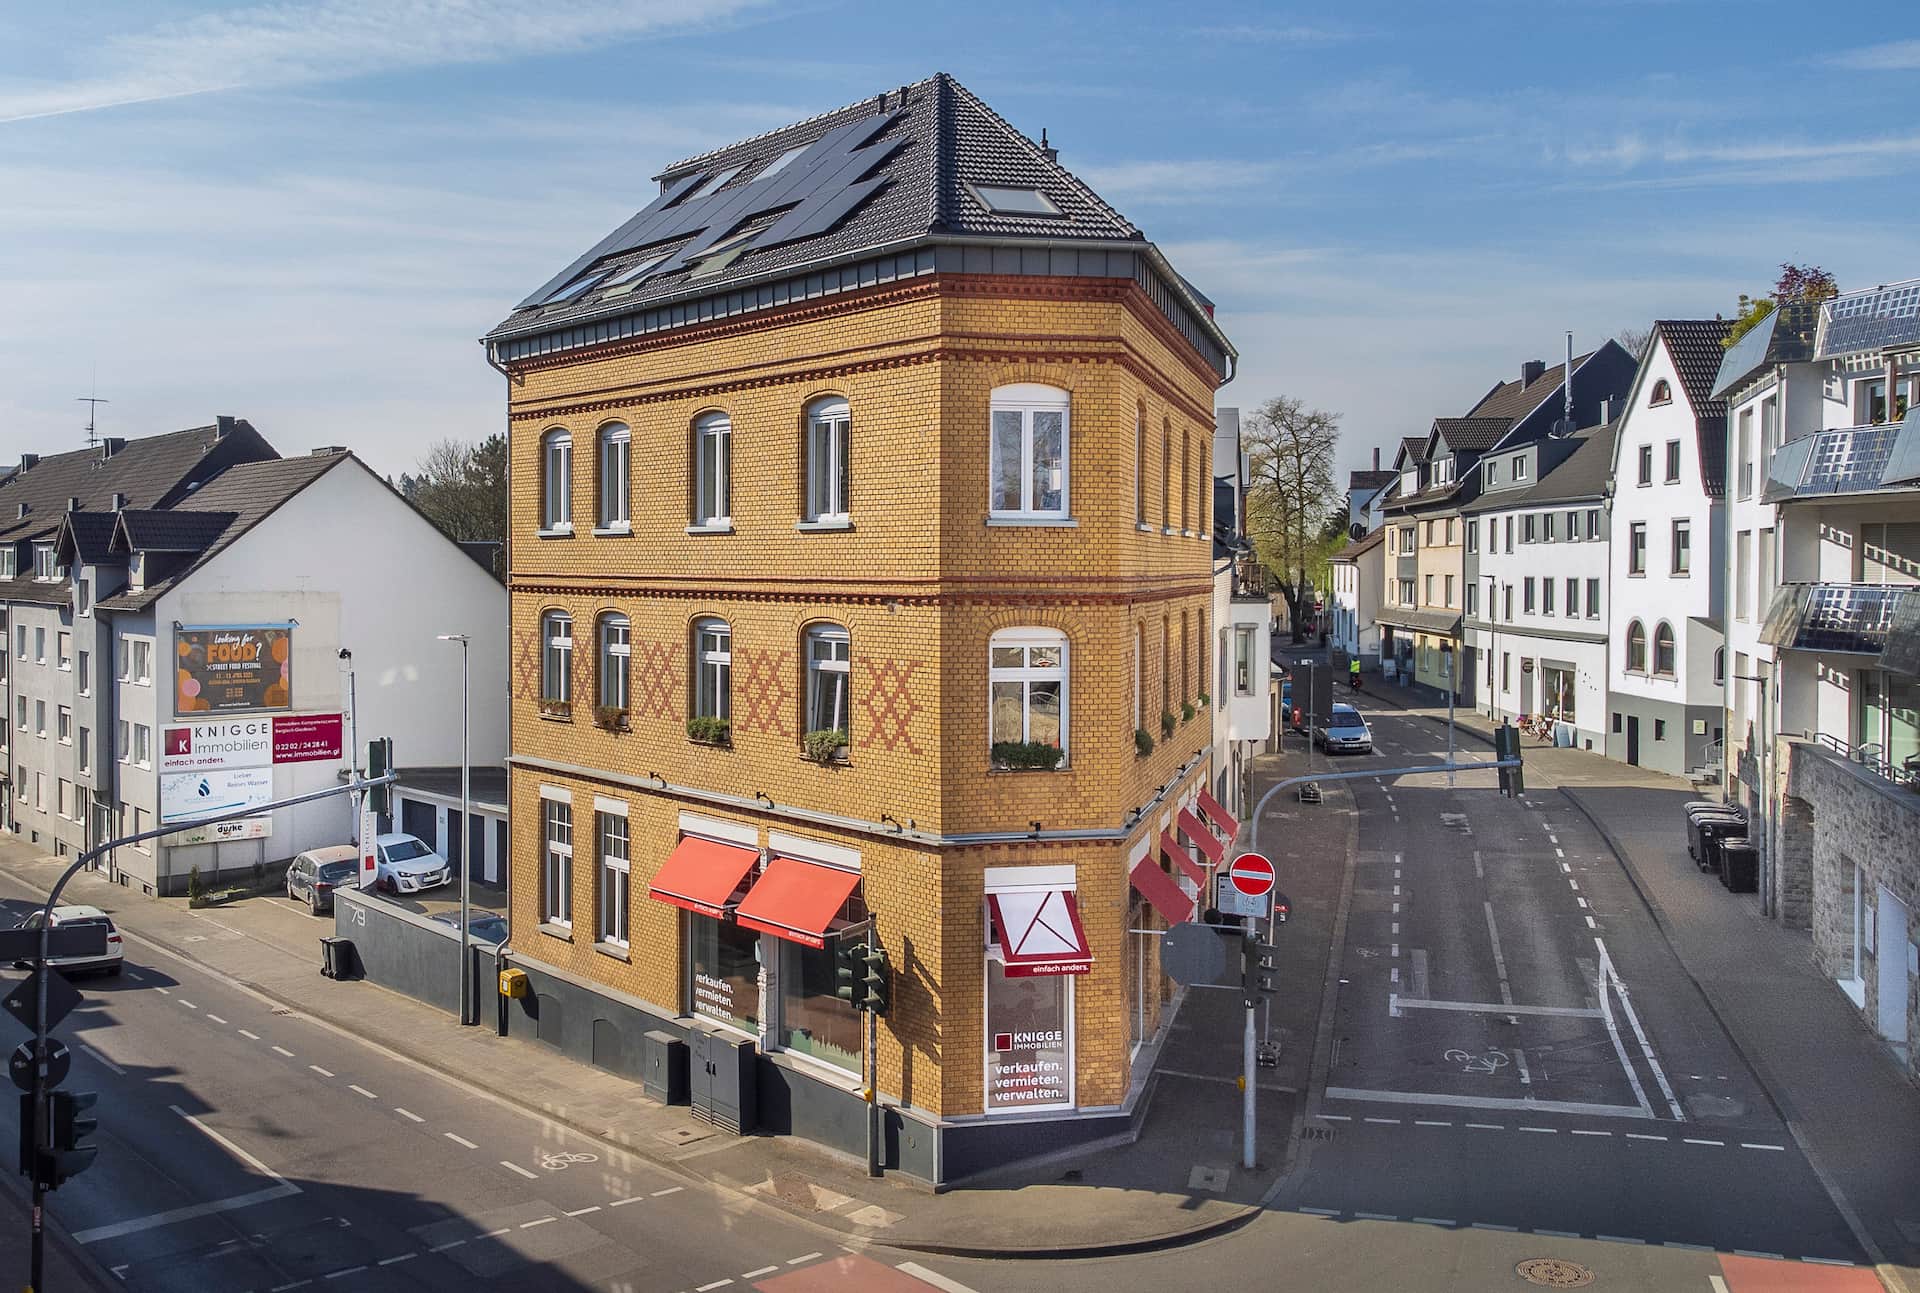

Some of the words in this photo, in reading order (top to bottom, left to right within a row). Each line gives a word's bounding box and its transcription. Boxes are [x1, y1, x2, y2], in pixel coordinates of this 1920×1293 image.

[214, 633, 240, 650] Looking
[241, 633, 254, 647] for
[195, 723, 268, 738] KNIGGE
[179, 740, 188, 752] K
[195, 740, 268, 754] Immobilien
[164, 759, 194, 767] einfach
[344, 902, 365, 926] 79
[1033, 965, 1060, 973] einfach
[1061, 964, 1088, 972] anders.
[1014, 1031, 1062, 1042] KNIGGE
[1014, 1042, 1063, 1050] IMMOBILIEN
[995, 1061, 1063, 1074] verkaufen.
[995, 1075, 1063, 1088] vermieten.
[995, 1088, 1063, 1101] verwalten.
